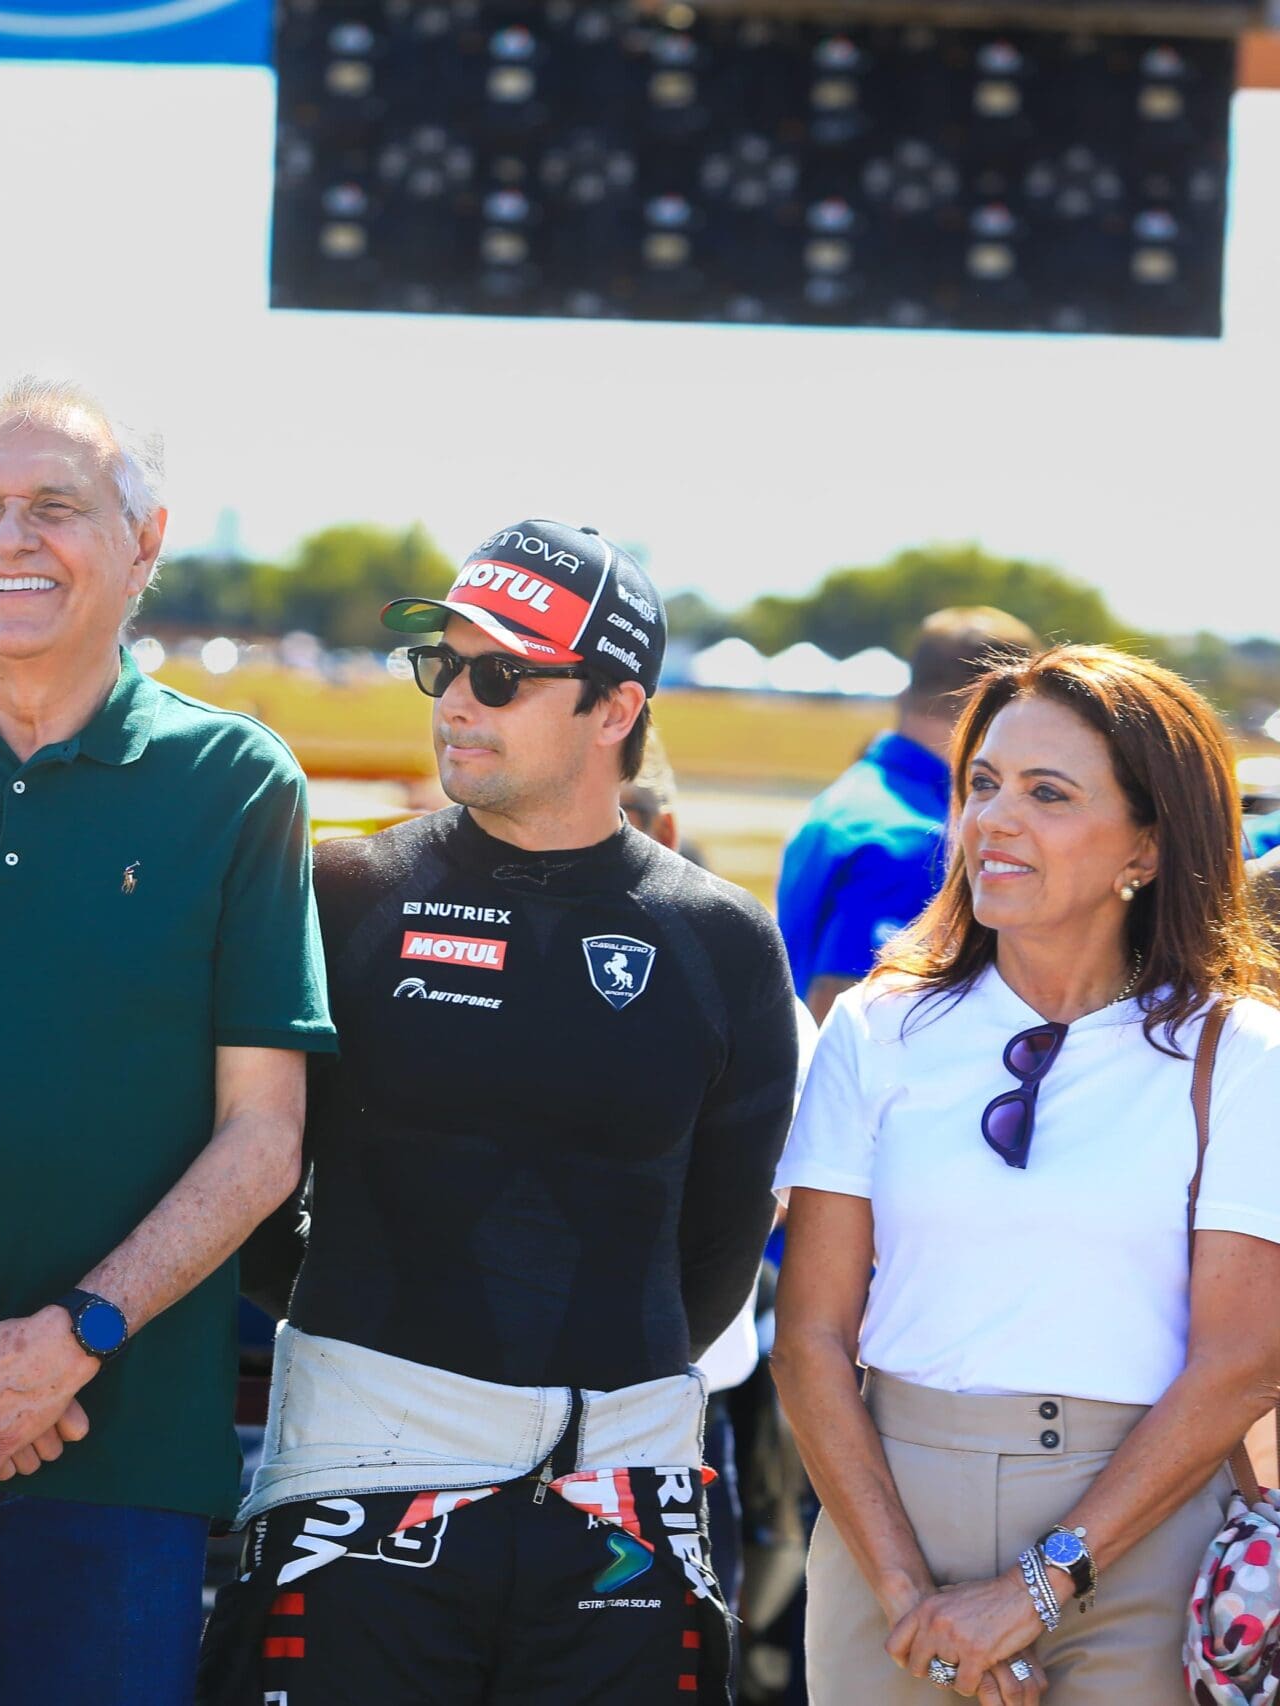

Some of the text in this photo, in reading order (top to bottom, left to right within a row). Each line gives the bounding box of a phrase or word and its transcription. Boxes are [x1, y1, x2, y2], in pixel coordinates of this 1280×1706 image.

[450, 563, 554, 613] MOTUL
[424, 902, 512, 924] NUTRIEX
[406, 937, 500, 965] MOTUL
[427, 989, 503, 1009] AUTOFORCE
[630, 1599, 662, 1608] SOLAR
